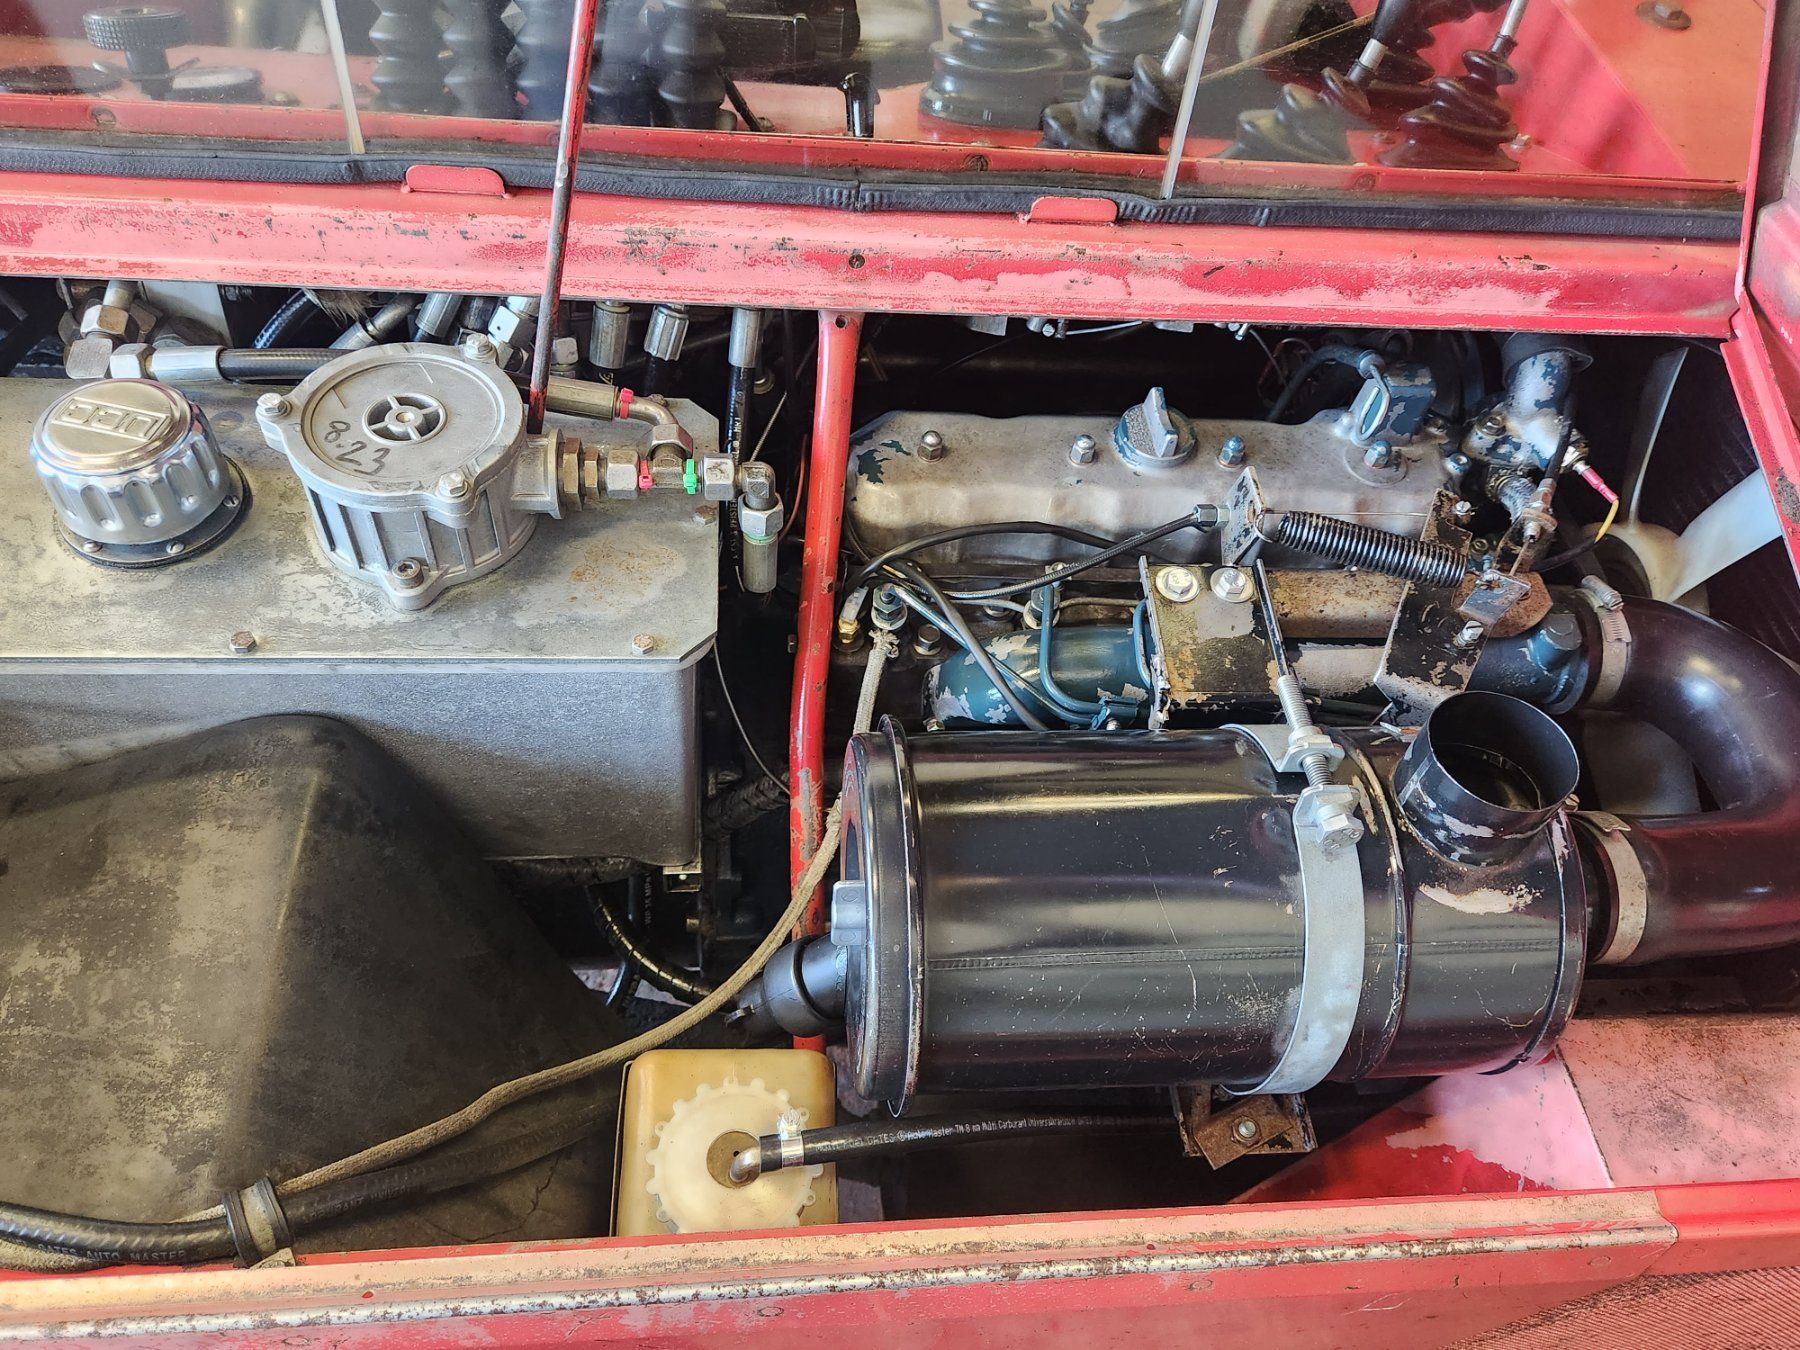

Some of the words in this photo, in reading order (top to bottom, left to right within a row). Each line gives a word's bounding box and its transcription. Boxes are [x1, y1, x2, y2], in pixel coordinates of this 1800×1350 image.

[324, 420, 391, 477] 8.23
[867, 1132, 895, 1146] GATES
[37, 1242, 78, 1256] GATES
[86, 1249, 121, 1262] AUTO
[129, 1249, 187, 1262] MASTER
